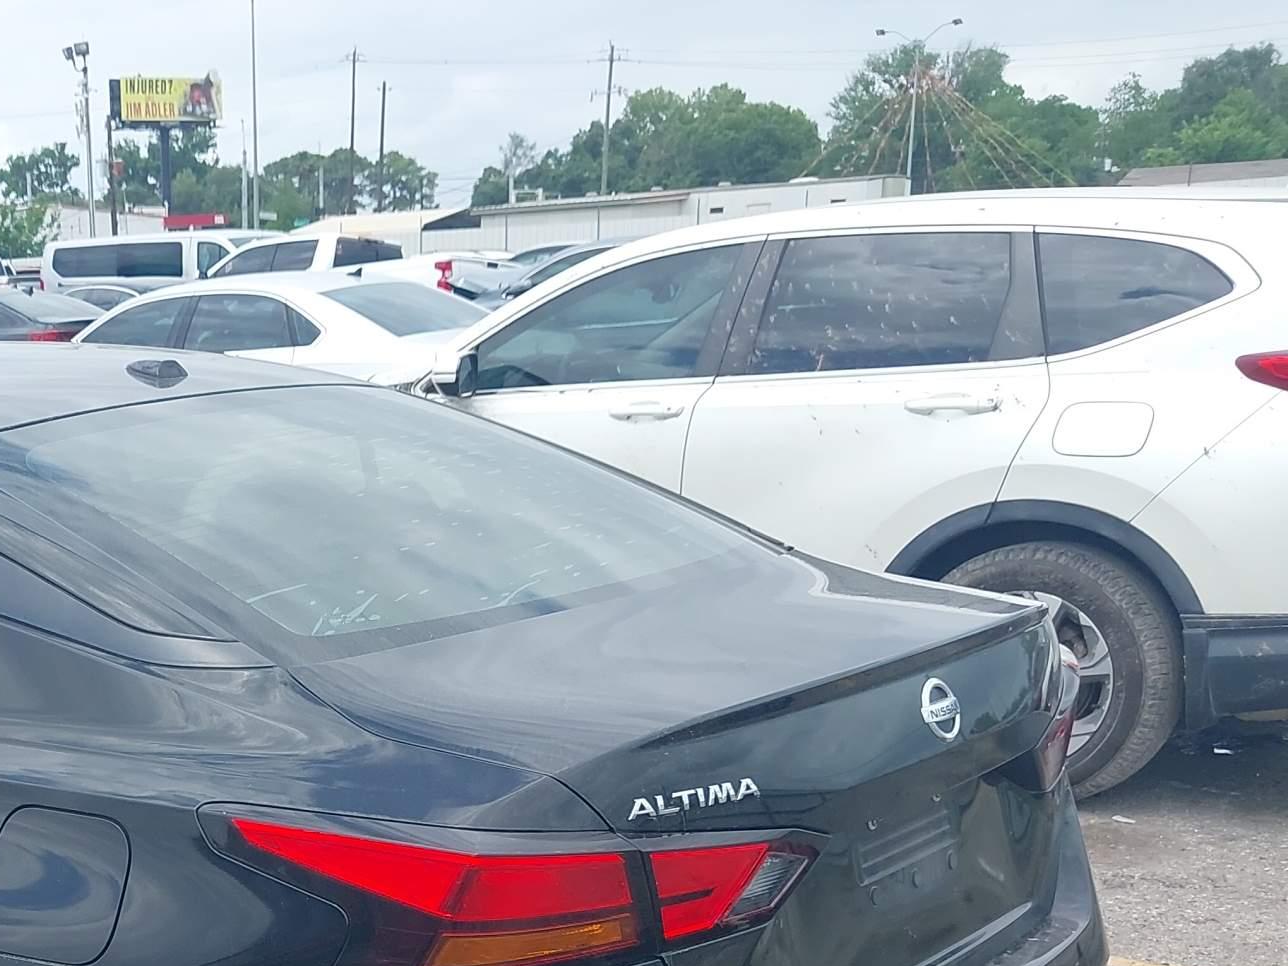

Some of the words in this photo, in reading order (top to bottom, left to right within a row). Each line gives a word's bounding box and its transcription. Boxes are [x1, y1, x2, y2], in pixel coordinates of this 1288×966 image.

[125, 78, 173, 95] INJURED?
[126, 102, 141, 118] JIM
[145, 102, 175, 118] ADLER
[628, 777, 761, 820] ALTIMA
